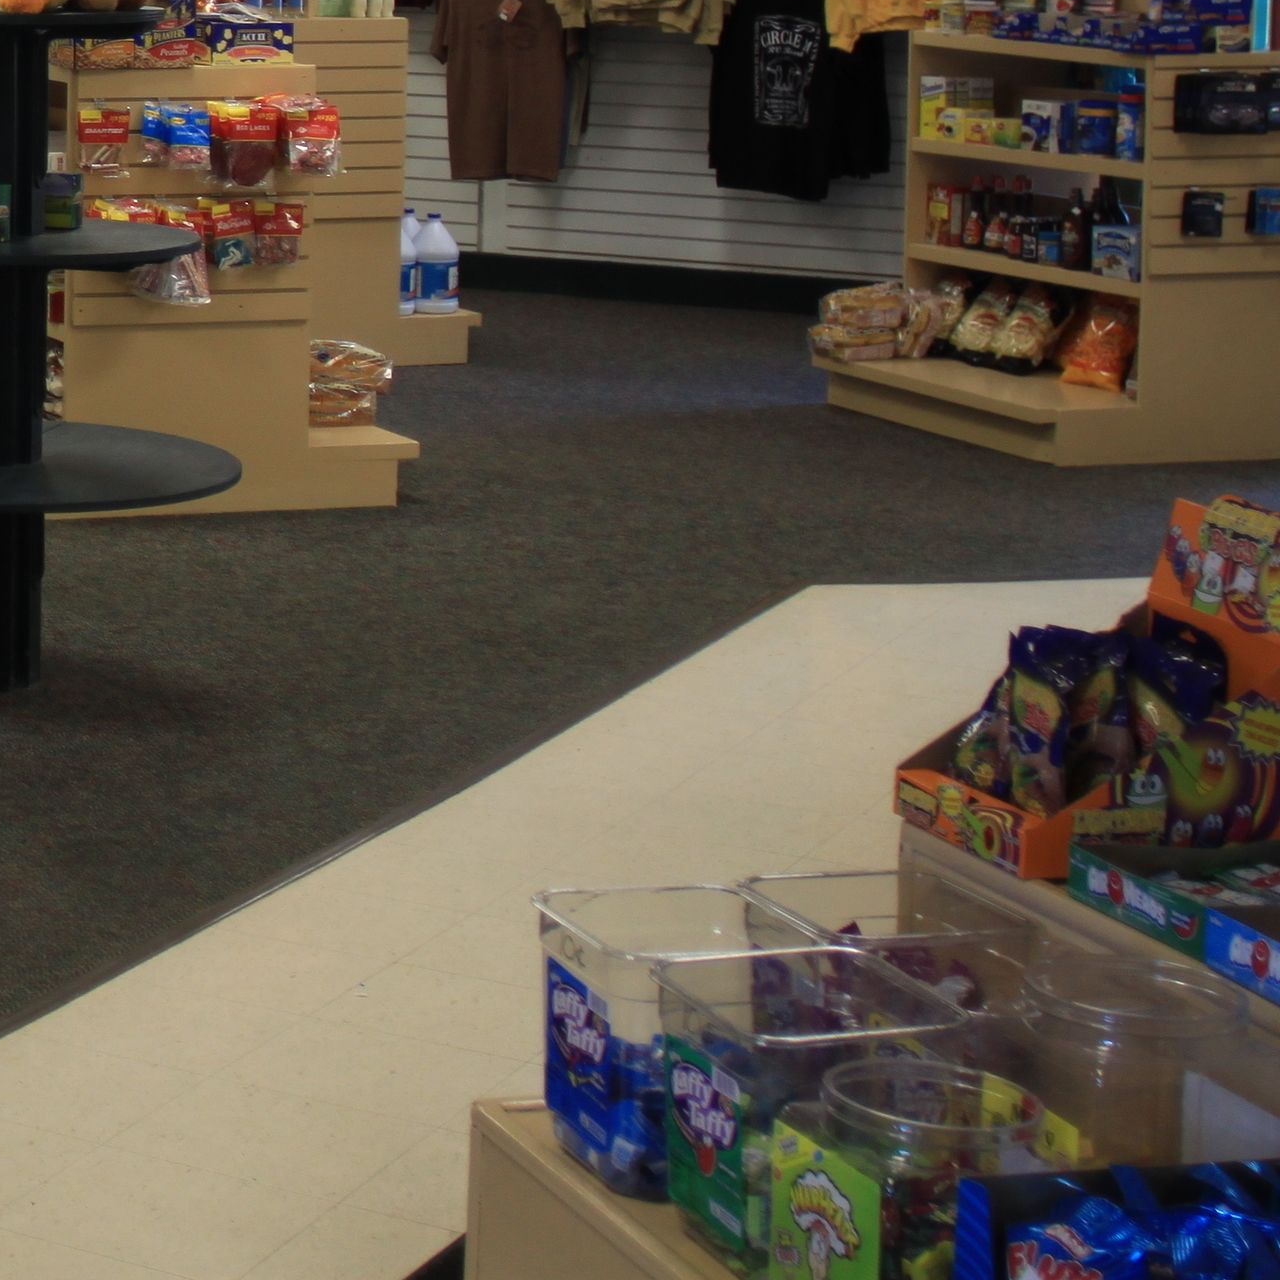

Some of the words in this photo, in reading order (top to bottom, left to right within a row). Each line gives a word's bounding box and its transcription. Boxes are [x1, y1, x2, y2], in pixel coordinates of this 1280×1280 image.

[159, 47, 189, 57] Peanuts
[241, 32, 256, 41] ACT
[761, 30, 803, 49] CIRCLE
[552, 988, 589, 1028] Laffy
[564, 1018, 607, 1065] Taffy
[671, 1069, 714, 1109] Laffy
[686, 1101, 737, 1148] Taffy
